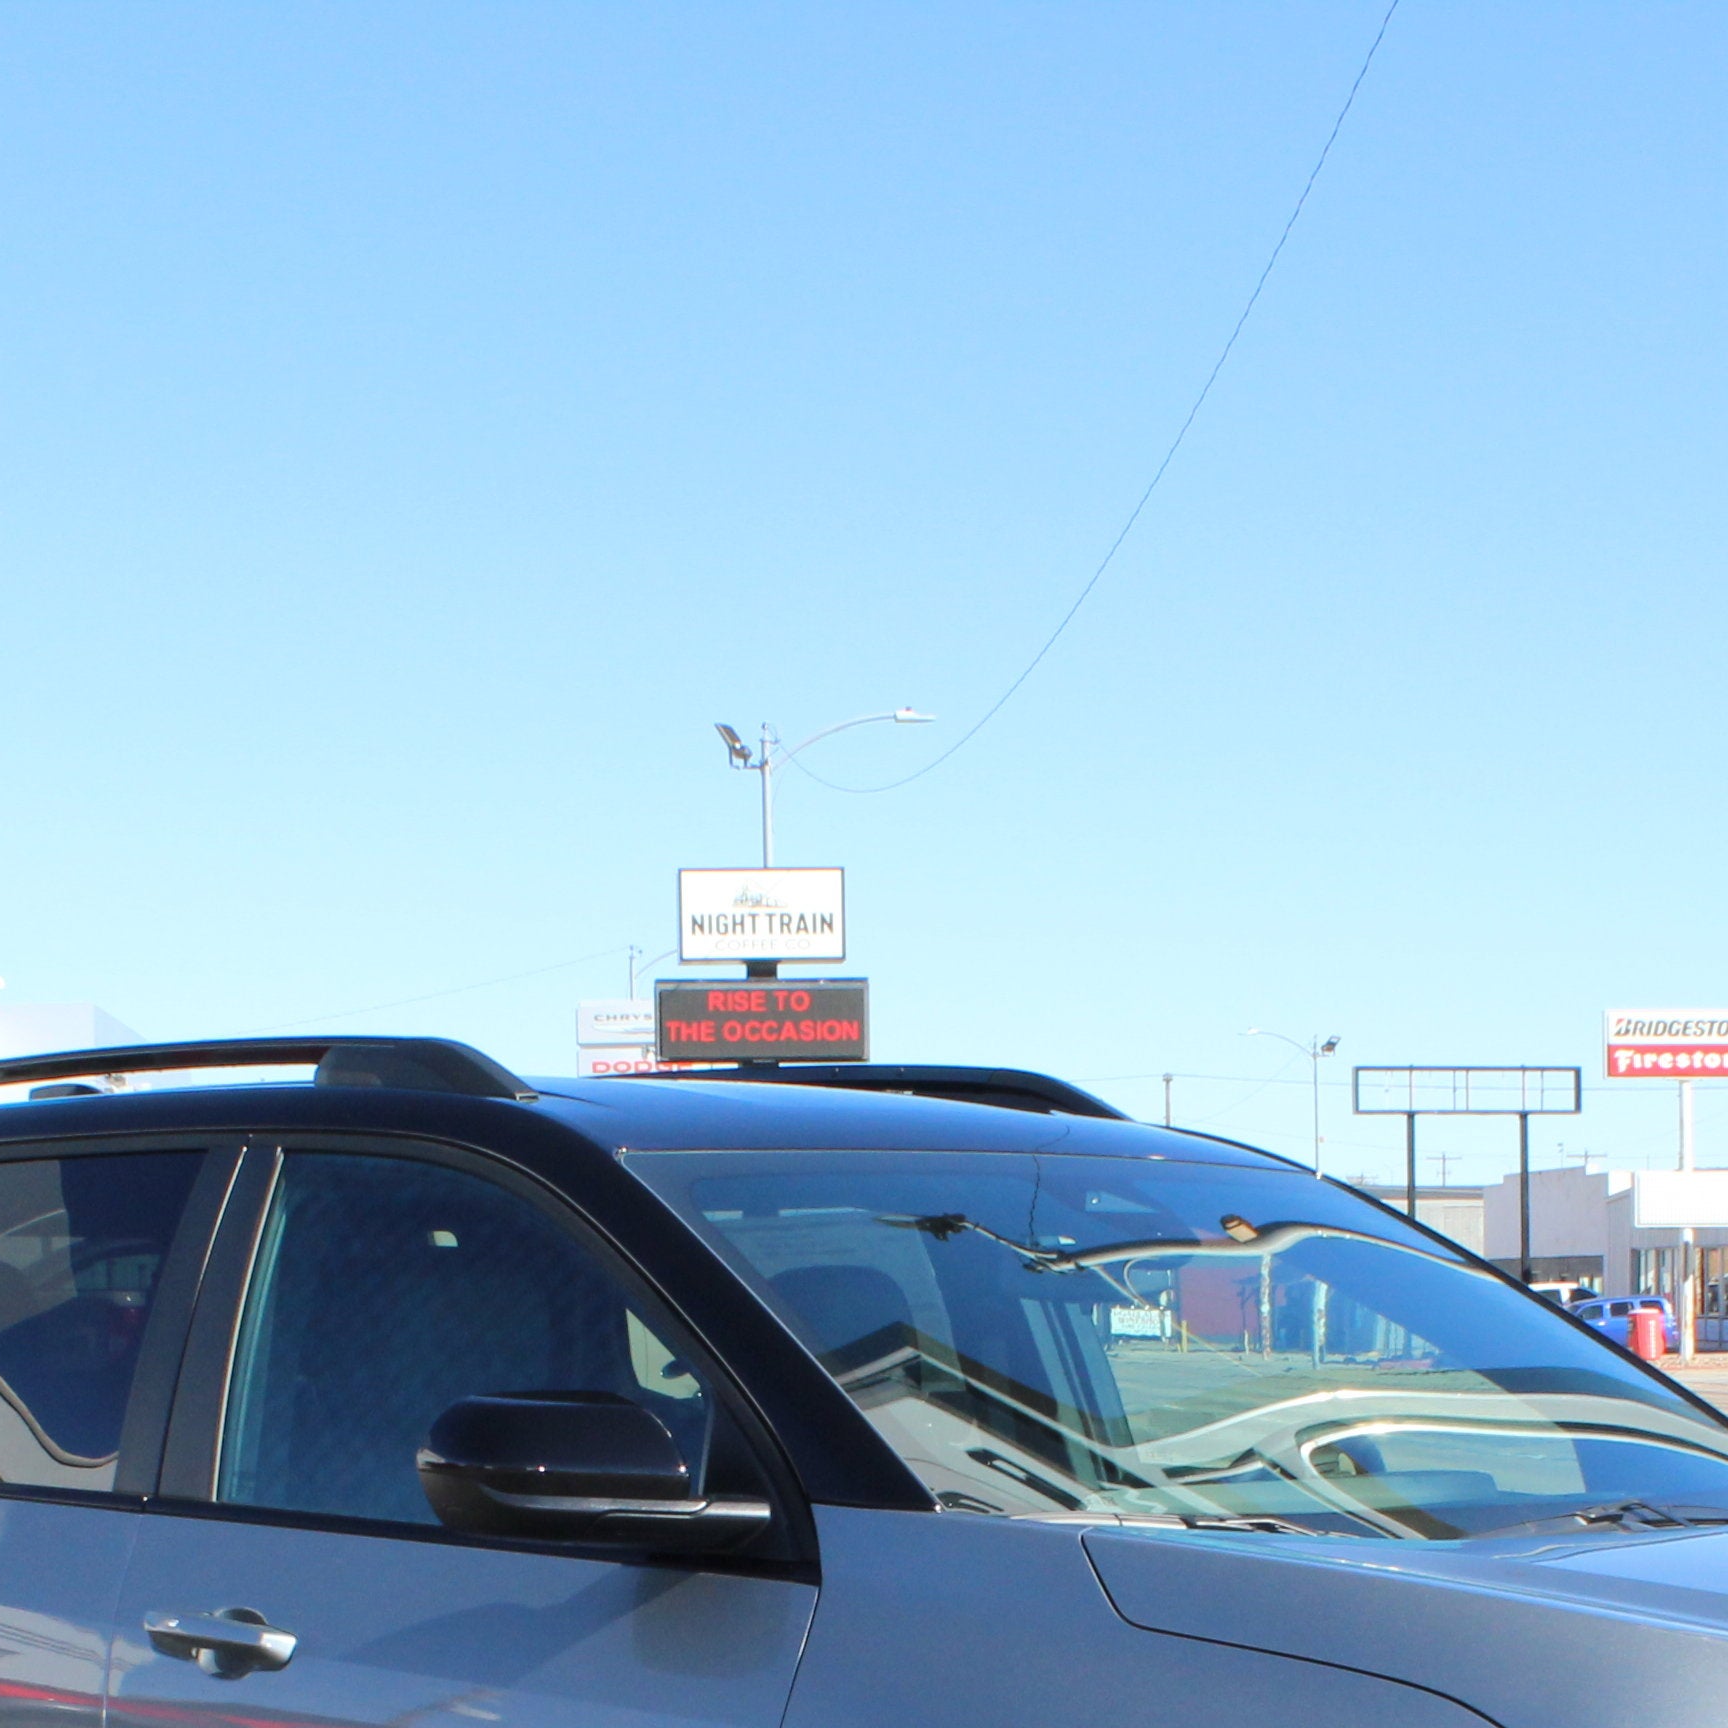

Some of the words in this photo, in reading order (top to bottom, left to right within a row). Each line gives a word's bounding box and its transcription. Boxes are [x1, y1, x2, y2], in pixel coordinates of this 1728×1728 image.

[690, 913, 760, 936] NIGHT
[767, 912, 835, 935] TRAIN
[706, 991, 768, 1013] RISE
[774, 991, 812, 1012] TO
[593, 1013, 654, 1023] CHRYS
[665, 1021, 716, 1043] THE
[721, 1020, 861, 1043] OCCASION
